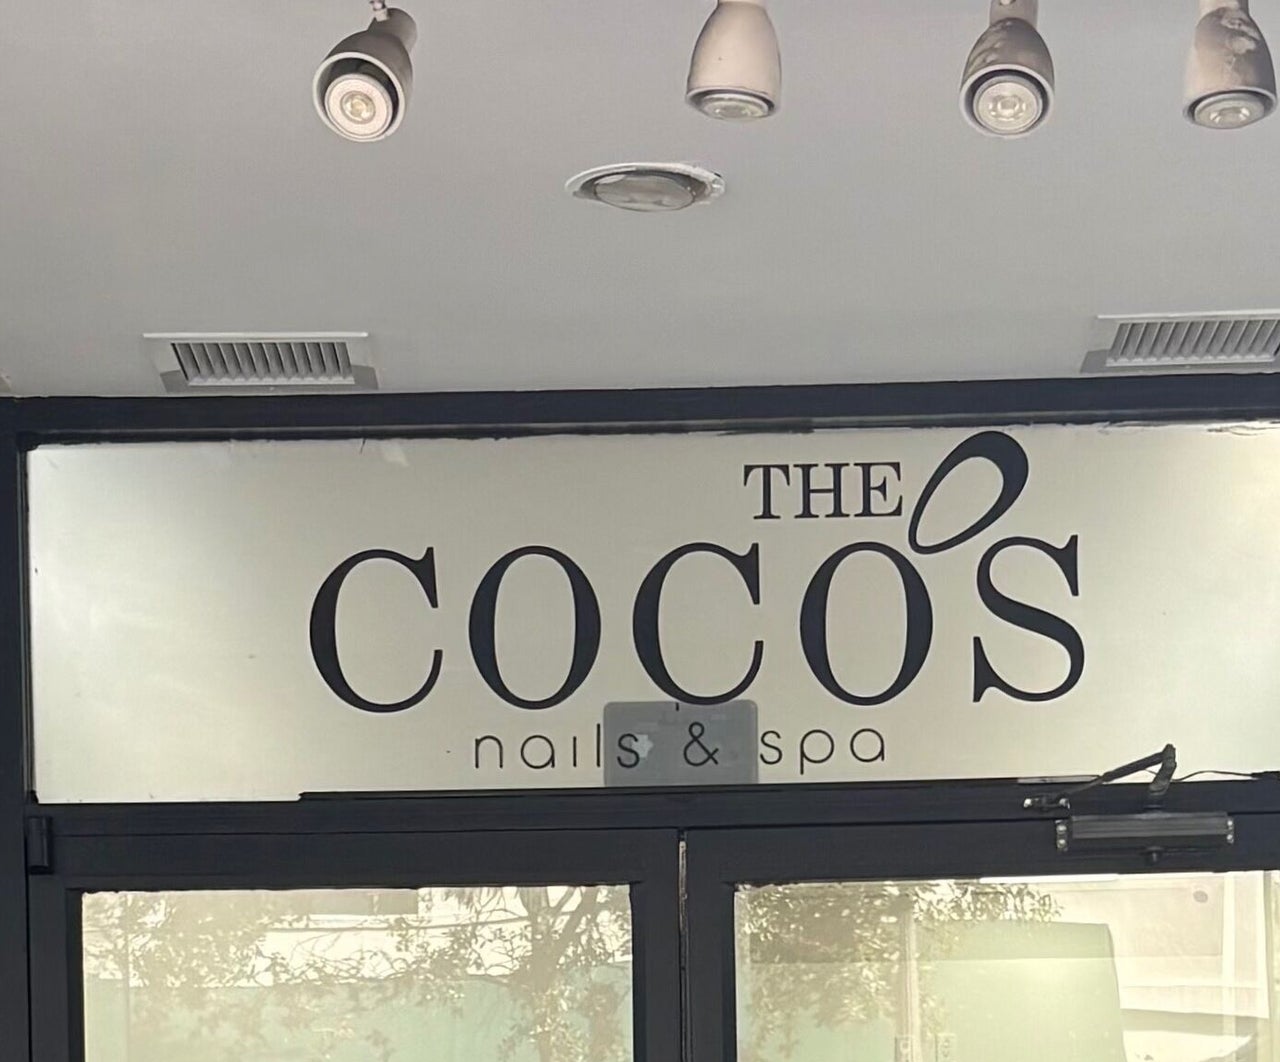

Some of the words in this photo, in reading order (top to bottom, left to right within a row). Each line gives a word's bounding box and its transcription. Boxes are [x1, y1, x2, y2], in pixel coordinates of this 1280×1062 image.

[744, 462, 902, 519] THE
[476, 724, 640, 769] nails
[683, 721, 719, 767] &
[760, 729, 884, 774] spa
